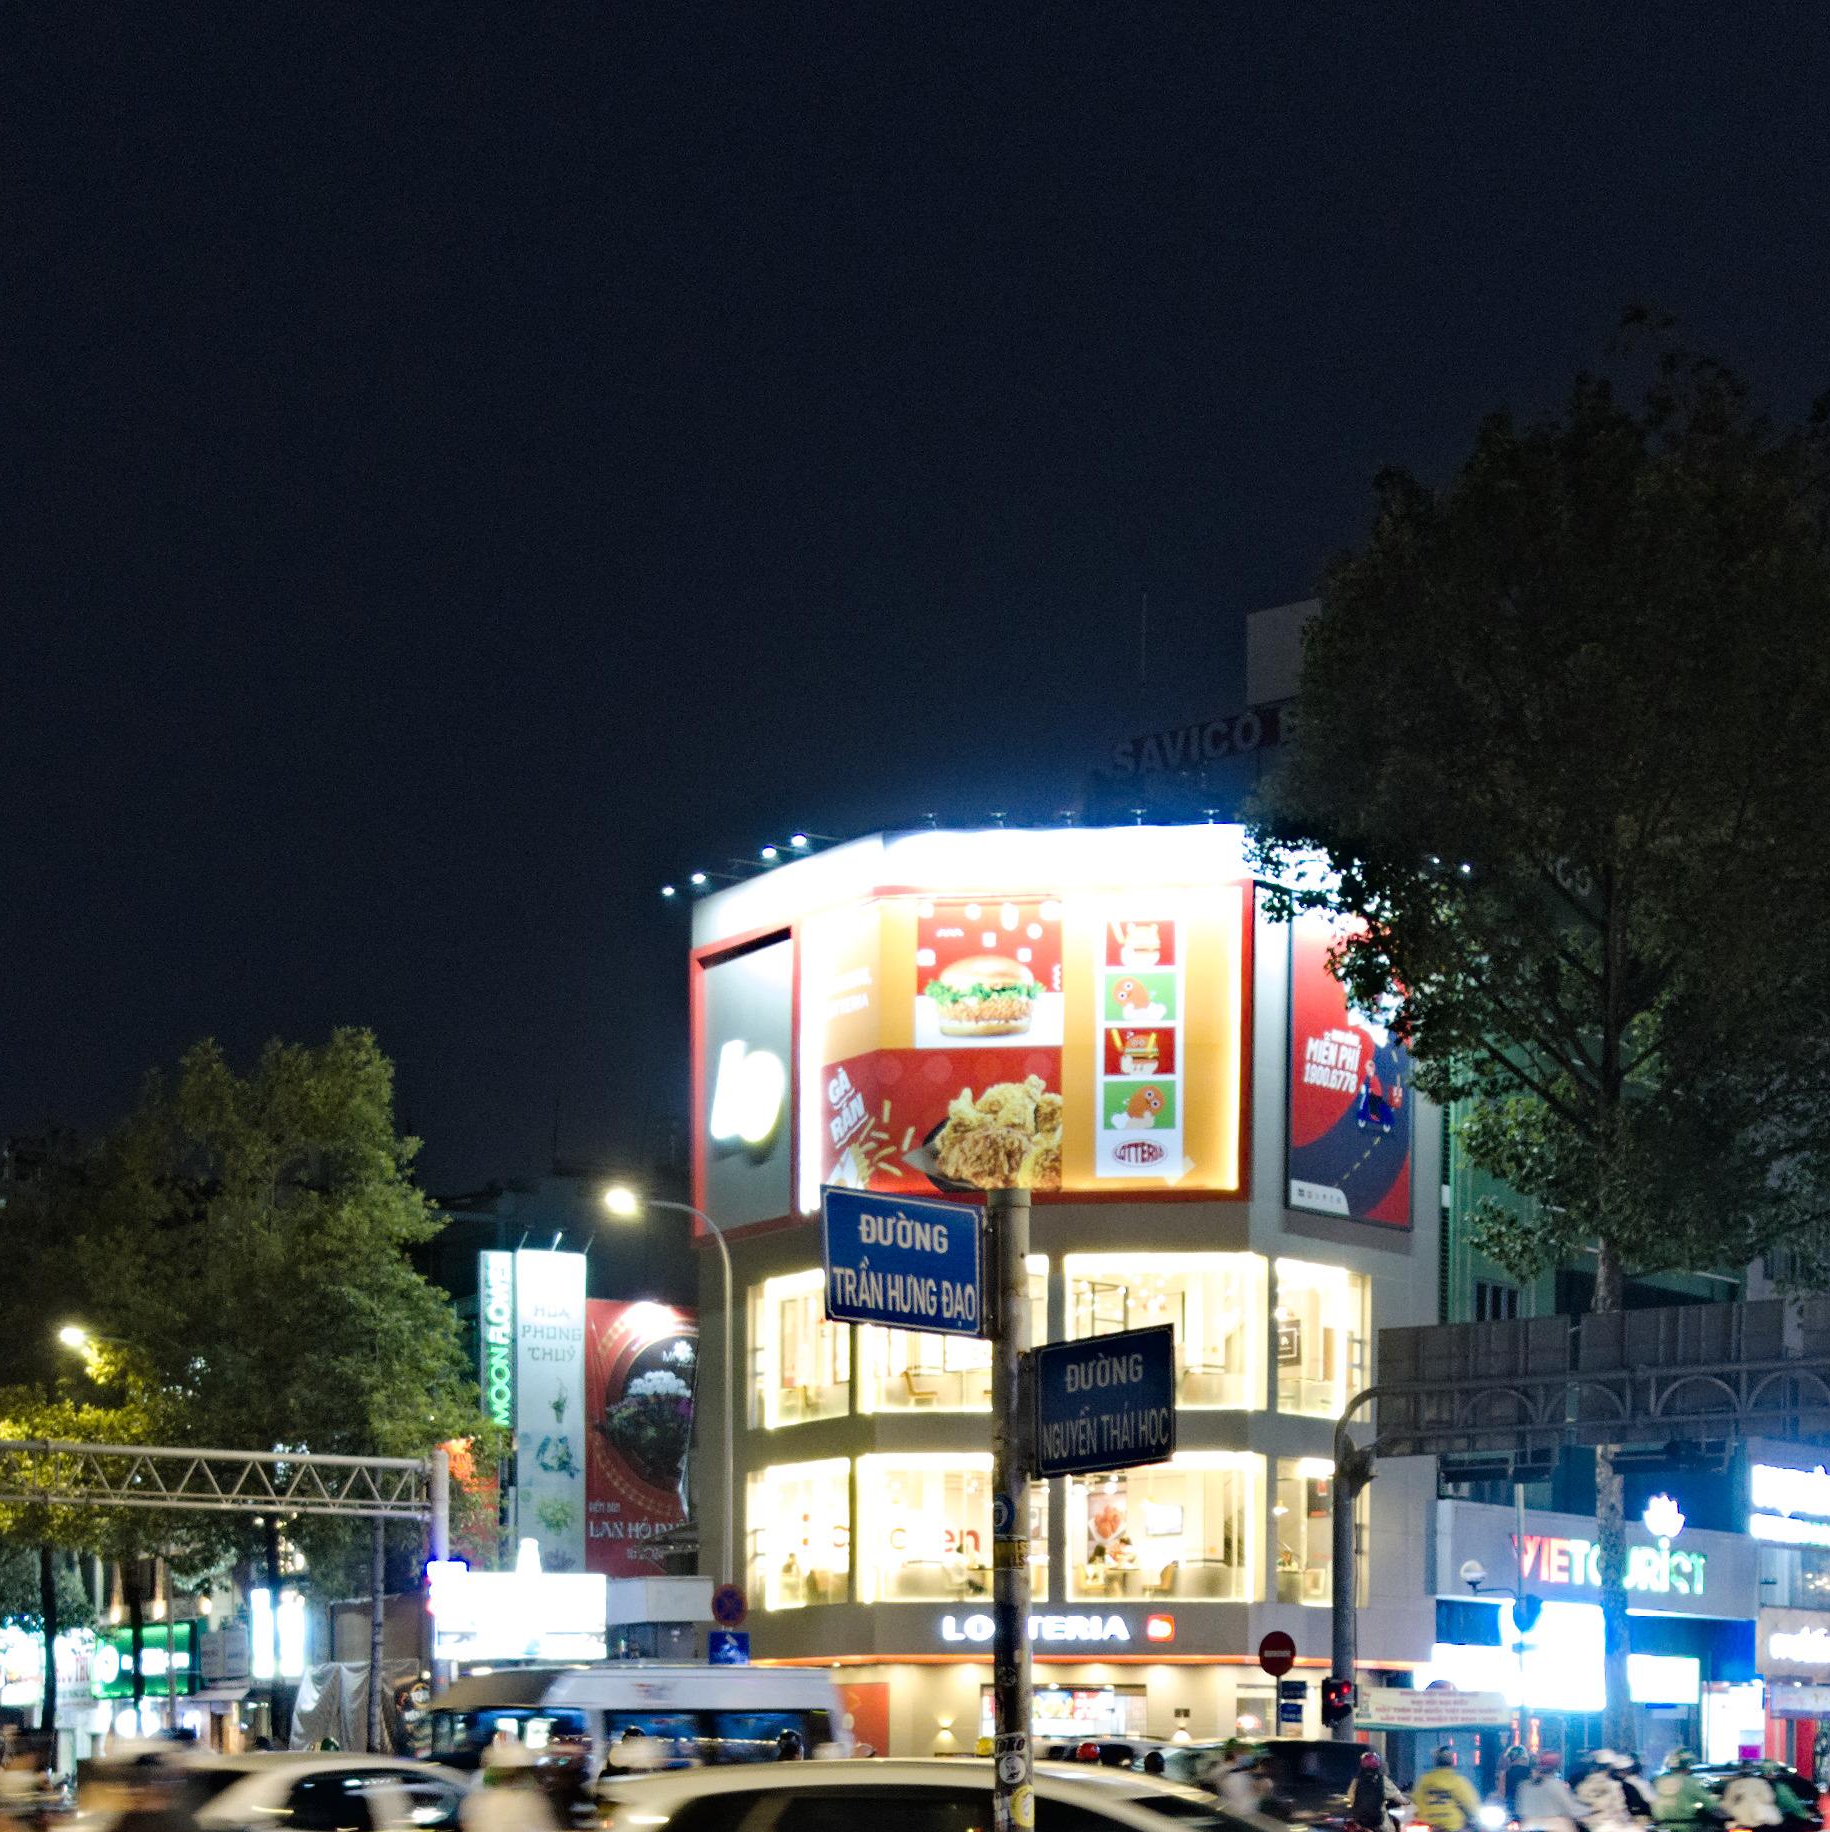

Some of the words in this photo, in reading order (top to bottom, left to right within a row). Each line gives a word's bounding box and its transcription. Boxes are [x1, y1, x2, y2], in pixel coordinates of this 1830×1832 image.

[858, 1210, 949, 1254] ĐƯỜNG
[832, 1255, 884, 1310] TRẦN
[886, 1273, 938, 1317] HƯNG
[940, 1280, 976, 1327] ĐẠO
[490, 1346, 511, 1426] MOON
[1064, 1352, 1143, 1393] ĐƯỜNG
[1043, 1406, 1097, 1460] NGUYỄN
[1101, 1401, 1134, 1452] THÁI
[1138, 1407, 1169, 1453] HỌC
[942, 1614, 1131, 1641] LOTERIA
